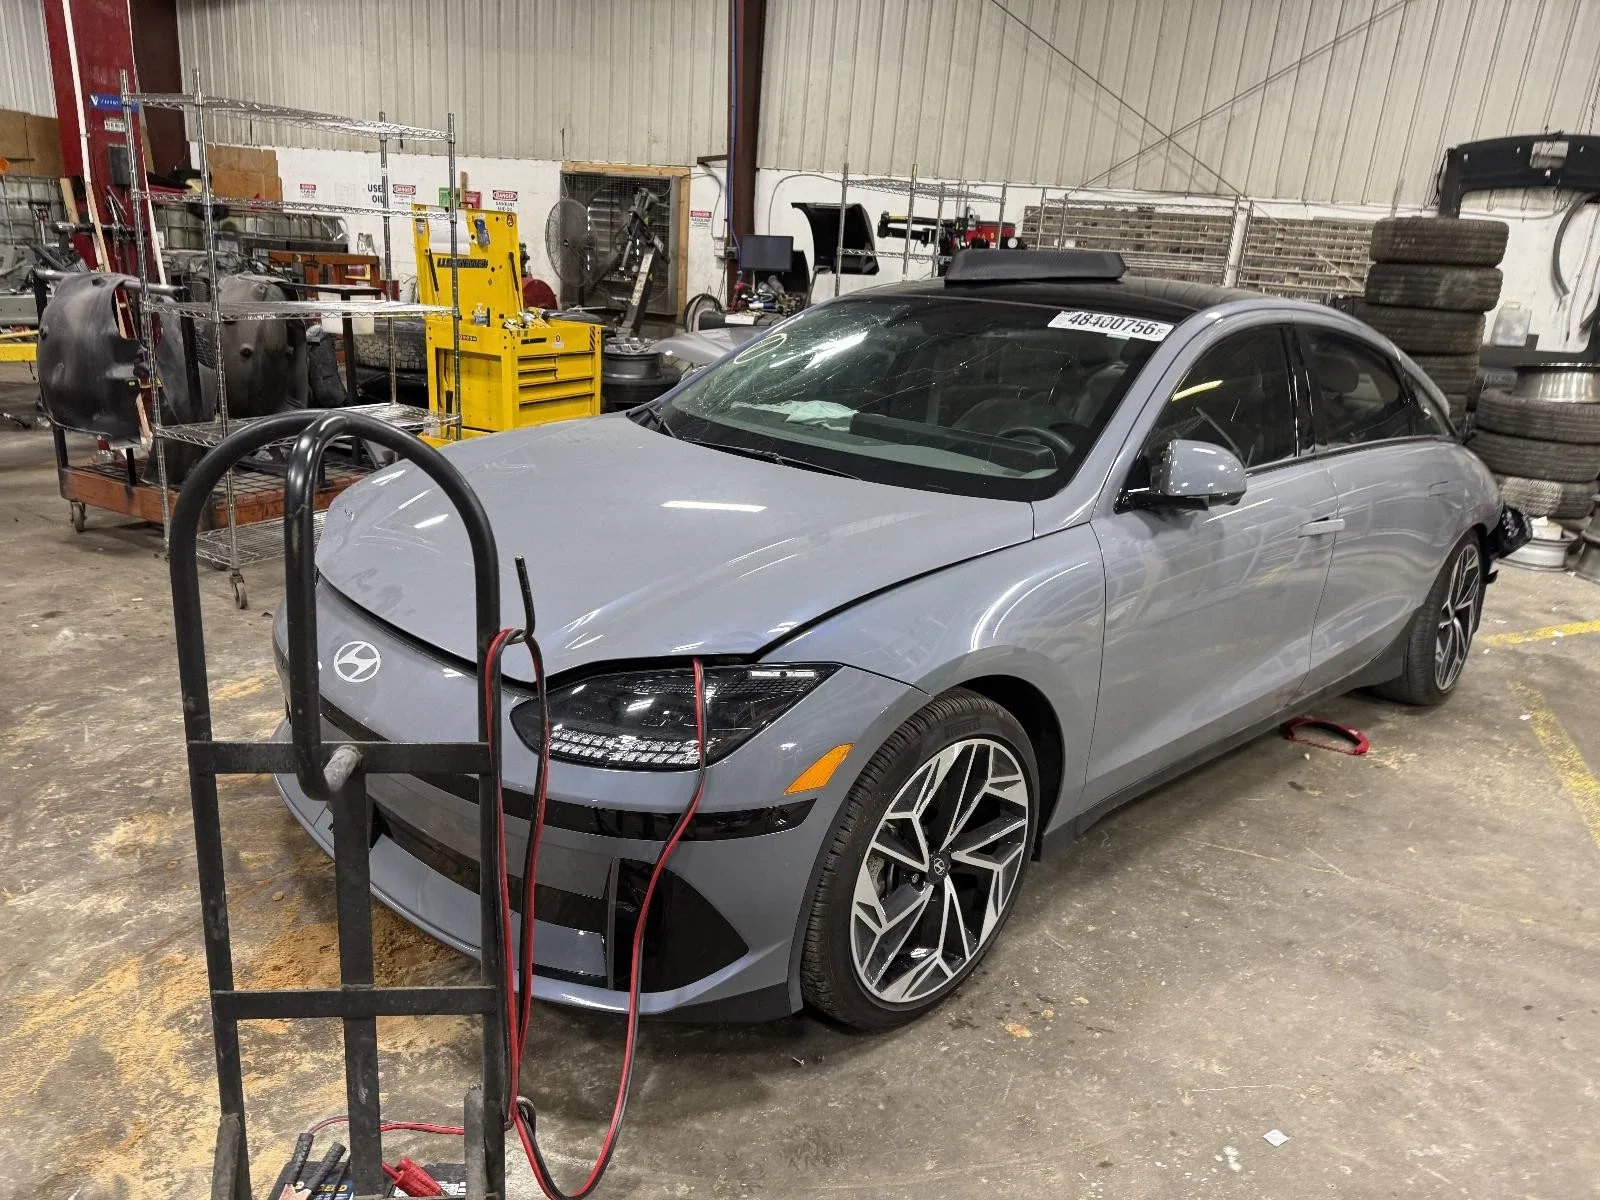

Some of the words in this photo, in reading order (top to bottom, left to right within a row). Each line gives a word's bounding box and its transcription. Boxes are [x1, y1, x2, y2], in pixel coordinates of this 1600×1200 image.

[367, 184, 383, 193] USE
[371, 194, 383, 203] OIL
[1068, 312, 1159, 335] 48400756
